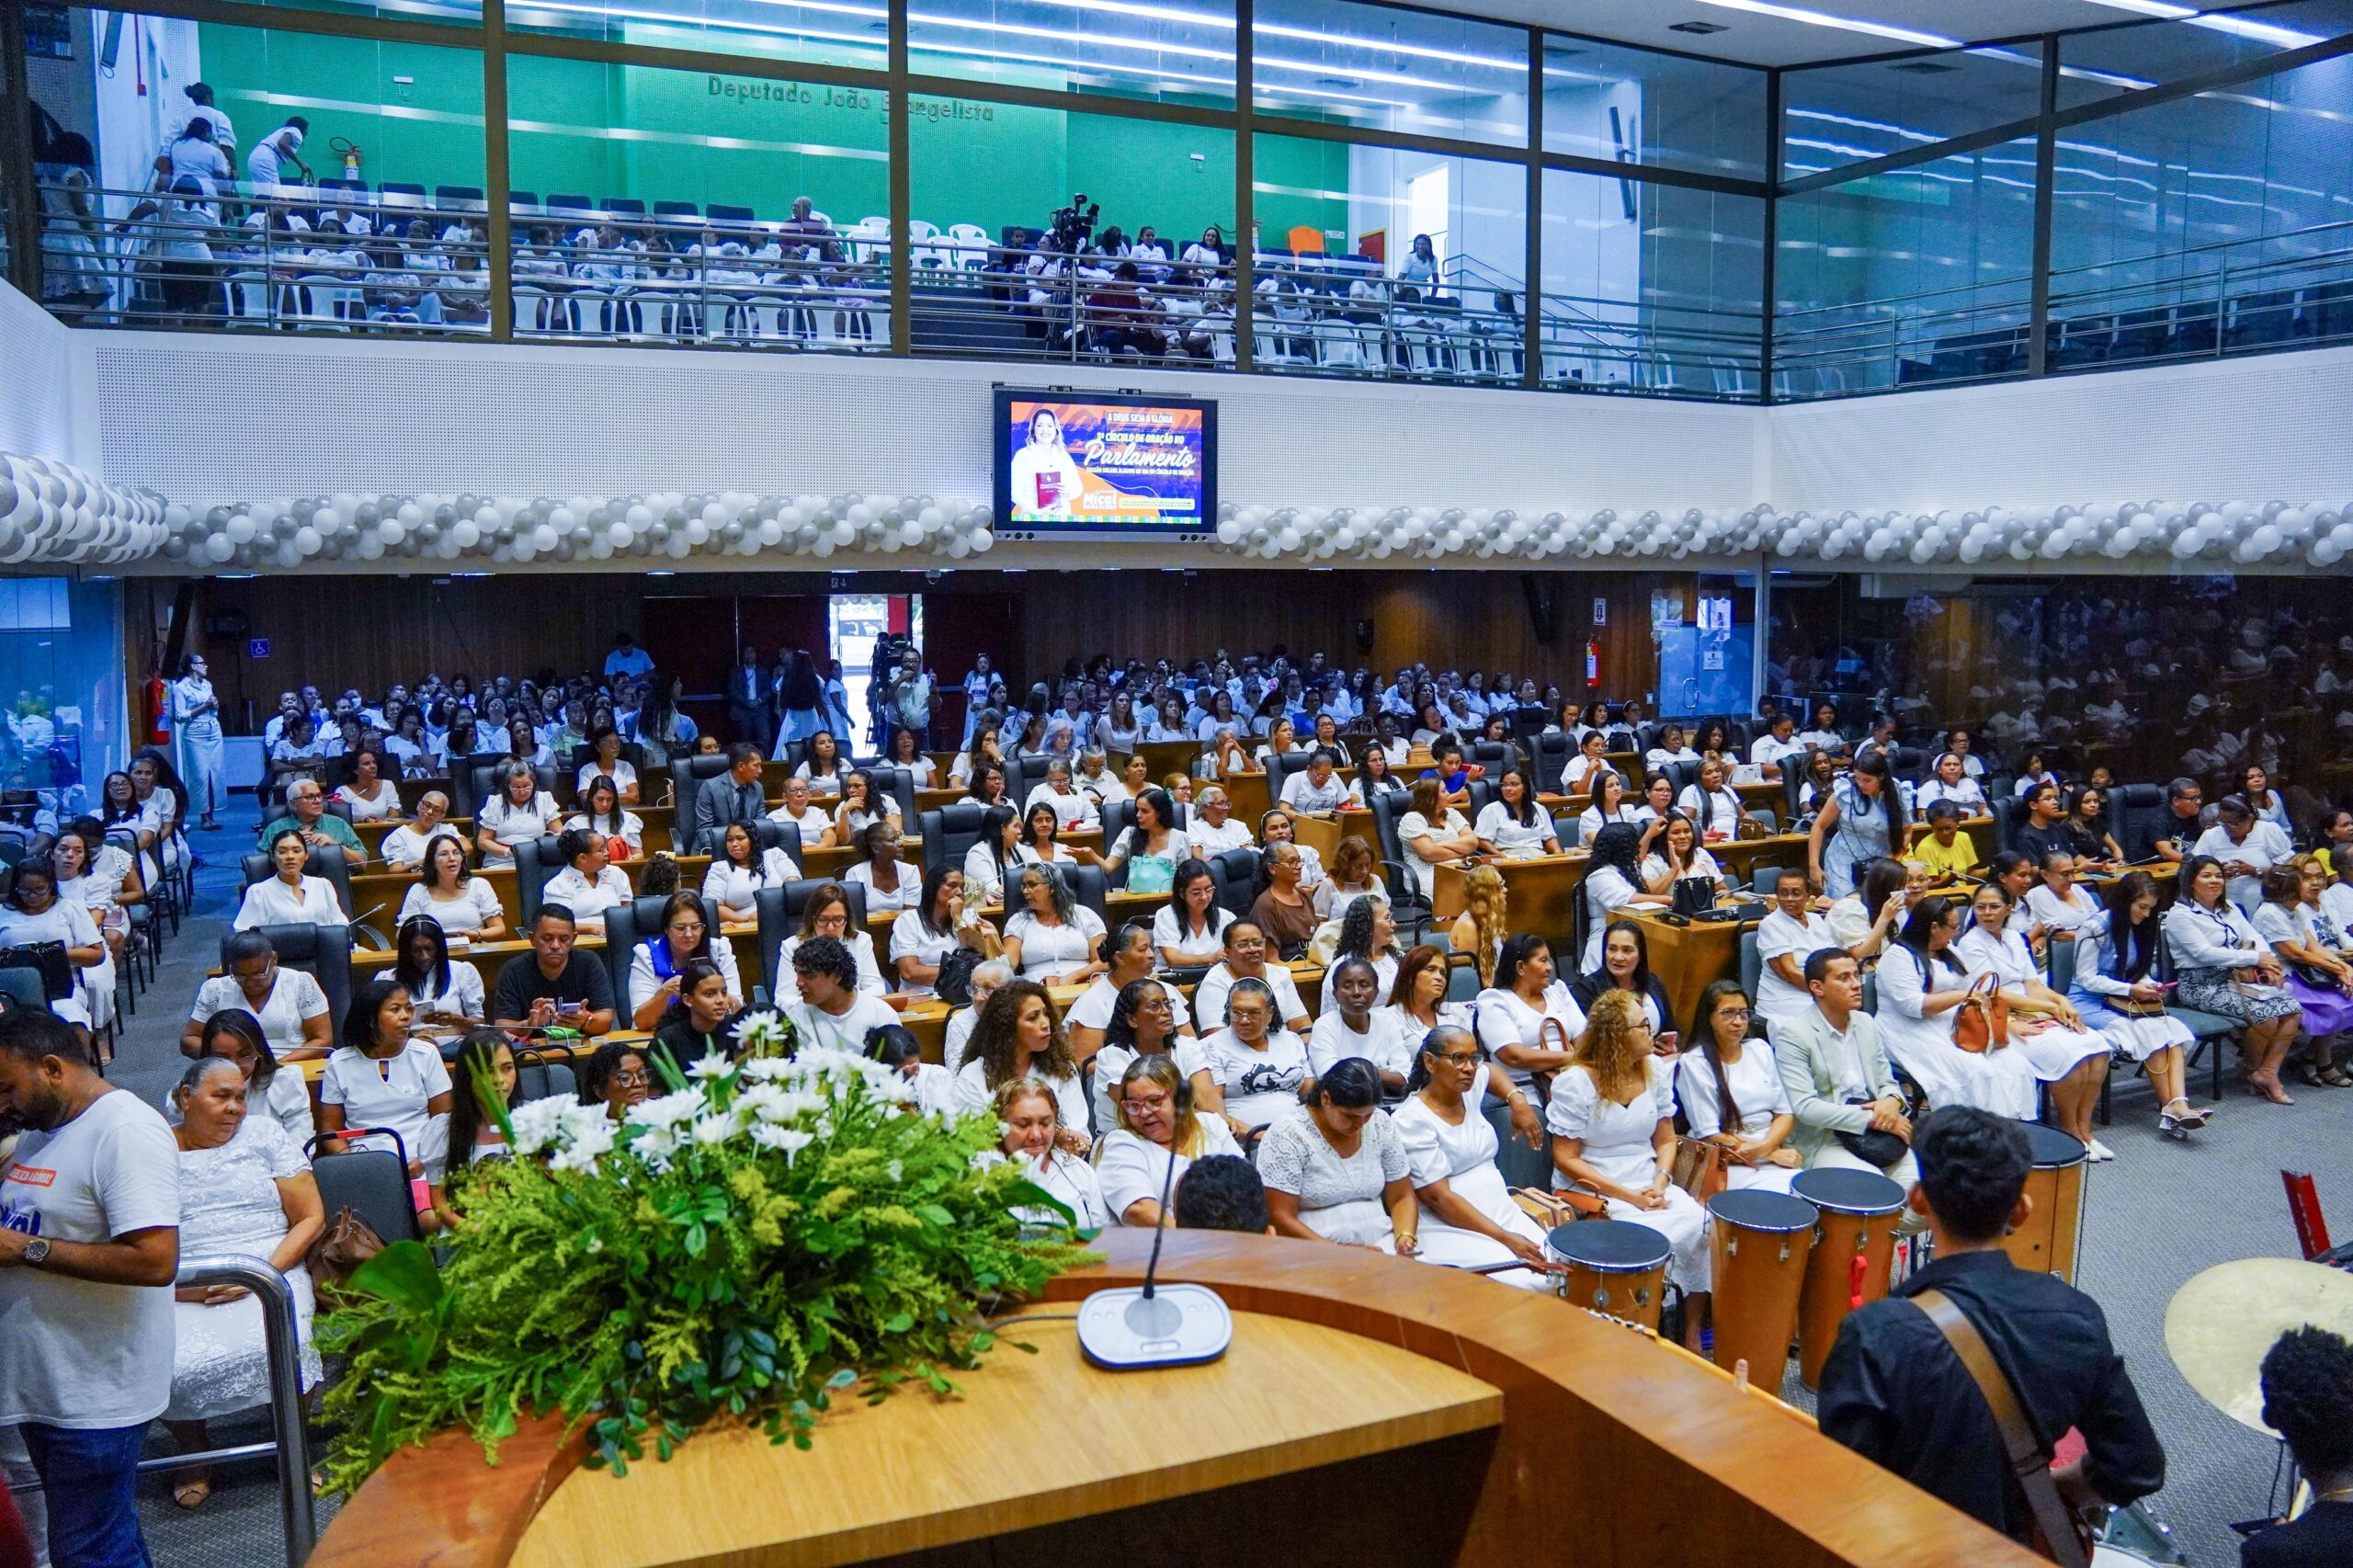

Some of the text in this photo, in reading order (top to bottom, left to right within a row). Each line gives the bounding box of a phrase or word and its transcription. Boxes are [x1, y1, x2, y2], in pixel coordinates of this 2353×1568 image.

[708, 74, 994, 122] Deputado João Eangelista
[1108, 413, 1173, 424] A DEUS SEJA A GLÓRIA
[1106, 431, 1134, 441] CÍRCULO
[1135, 435, 1145, 443] DE
[1146, 434, 1174, 445] ORAÇÃO
[1175, 436, 1185, 444] NO
[1084, 439, 1196, 467] Parlamento
